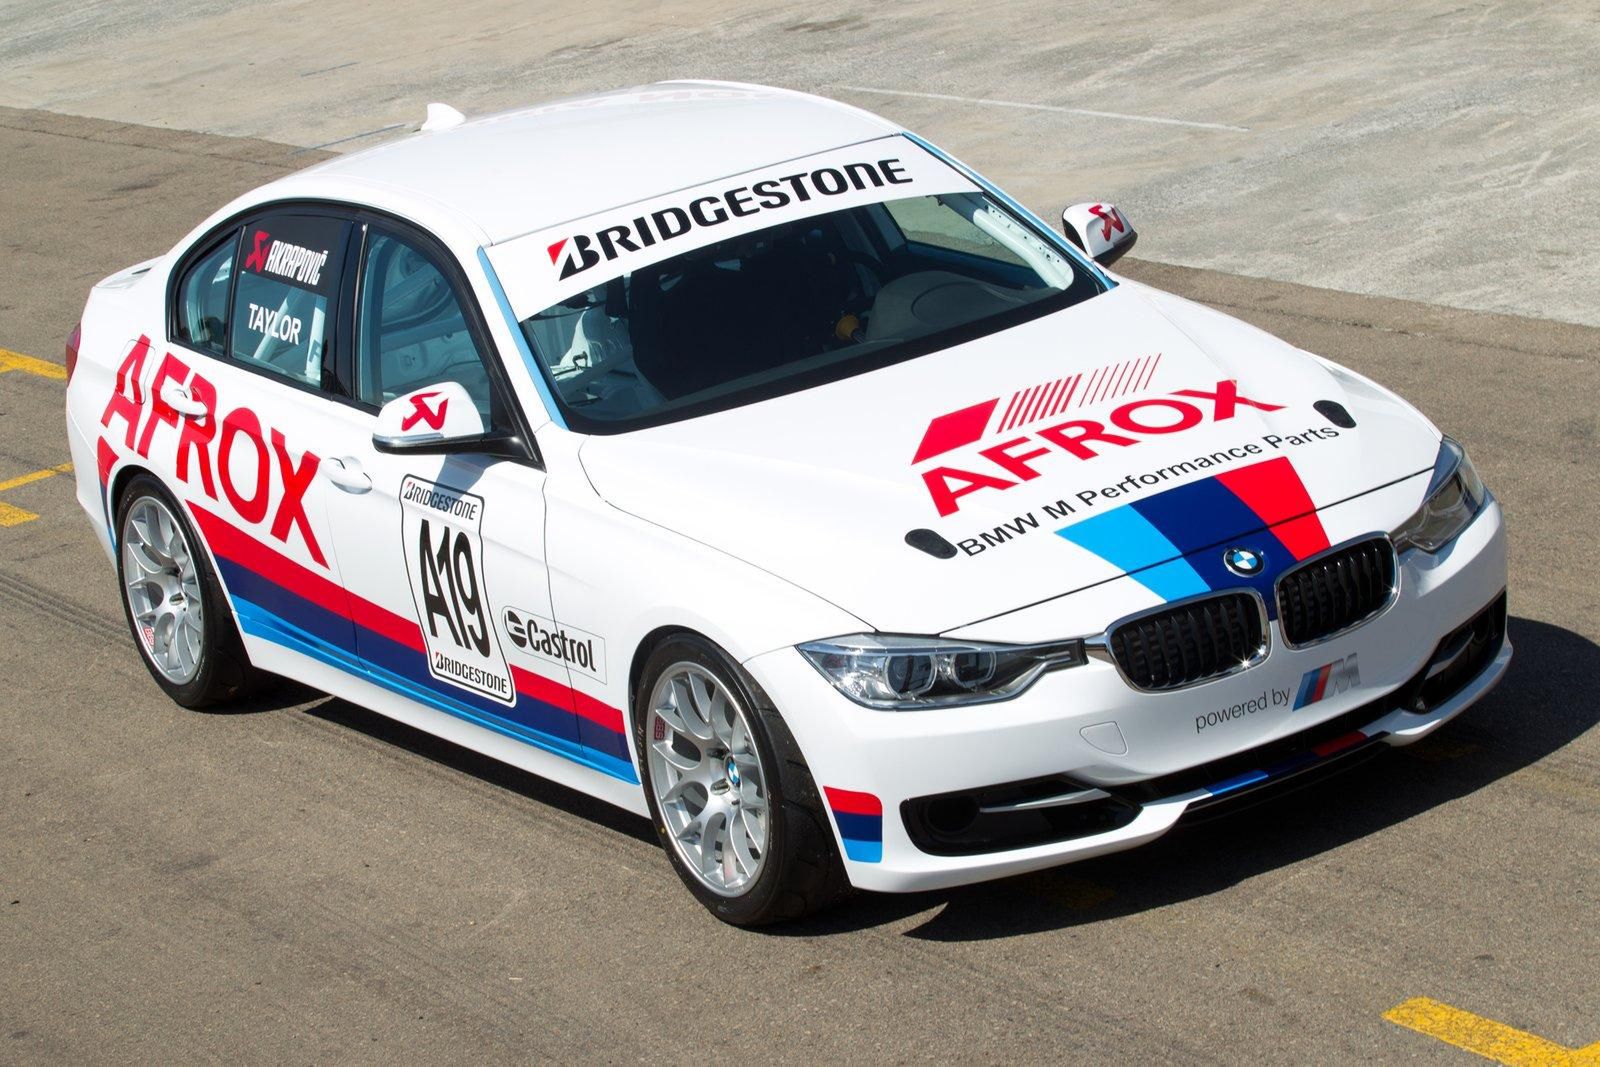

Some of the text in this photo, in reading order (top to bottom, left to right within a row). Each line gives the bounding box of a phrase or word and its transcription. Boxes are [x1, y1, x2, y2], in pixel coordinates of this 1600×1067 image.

[547, 158, 913, 281] BRIDGESTONE
[249, 303, 301, 346] TAYLOR
[101, 334, 331, 570] AFROX
[922, 379, 1289, 518] AFROX
[957, 424, 1340, 557] BMW M Performance Parts
[403, 481, 478, 520] BRIDGESTONE
[419, 518, 491, 658] A19
[435, 652, 508, 694] BRIDGESTONE
[526, 619, 597, 672] Castrol
[1195, 690, 1268, 734] powered
[1273, 687, 1291, 708] by
